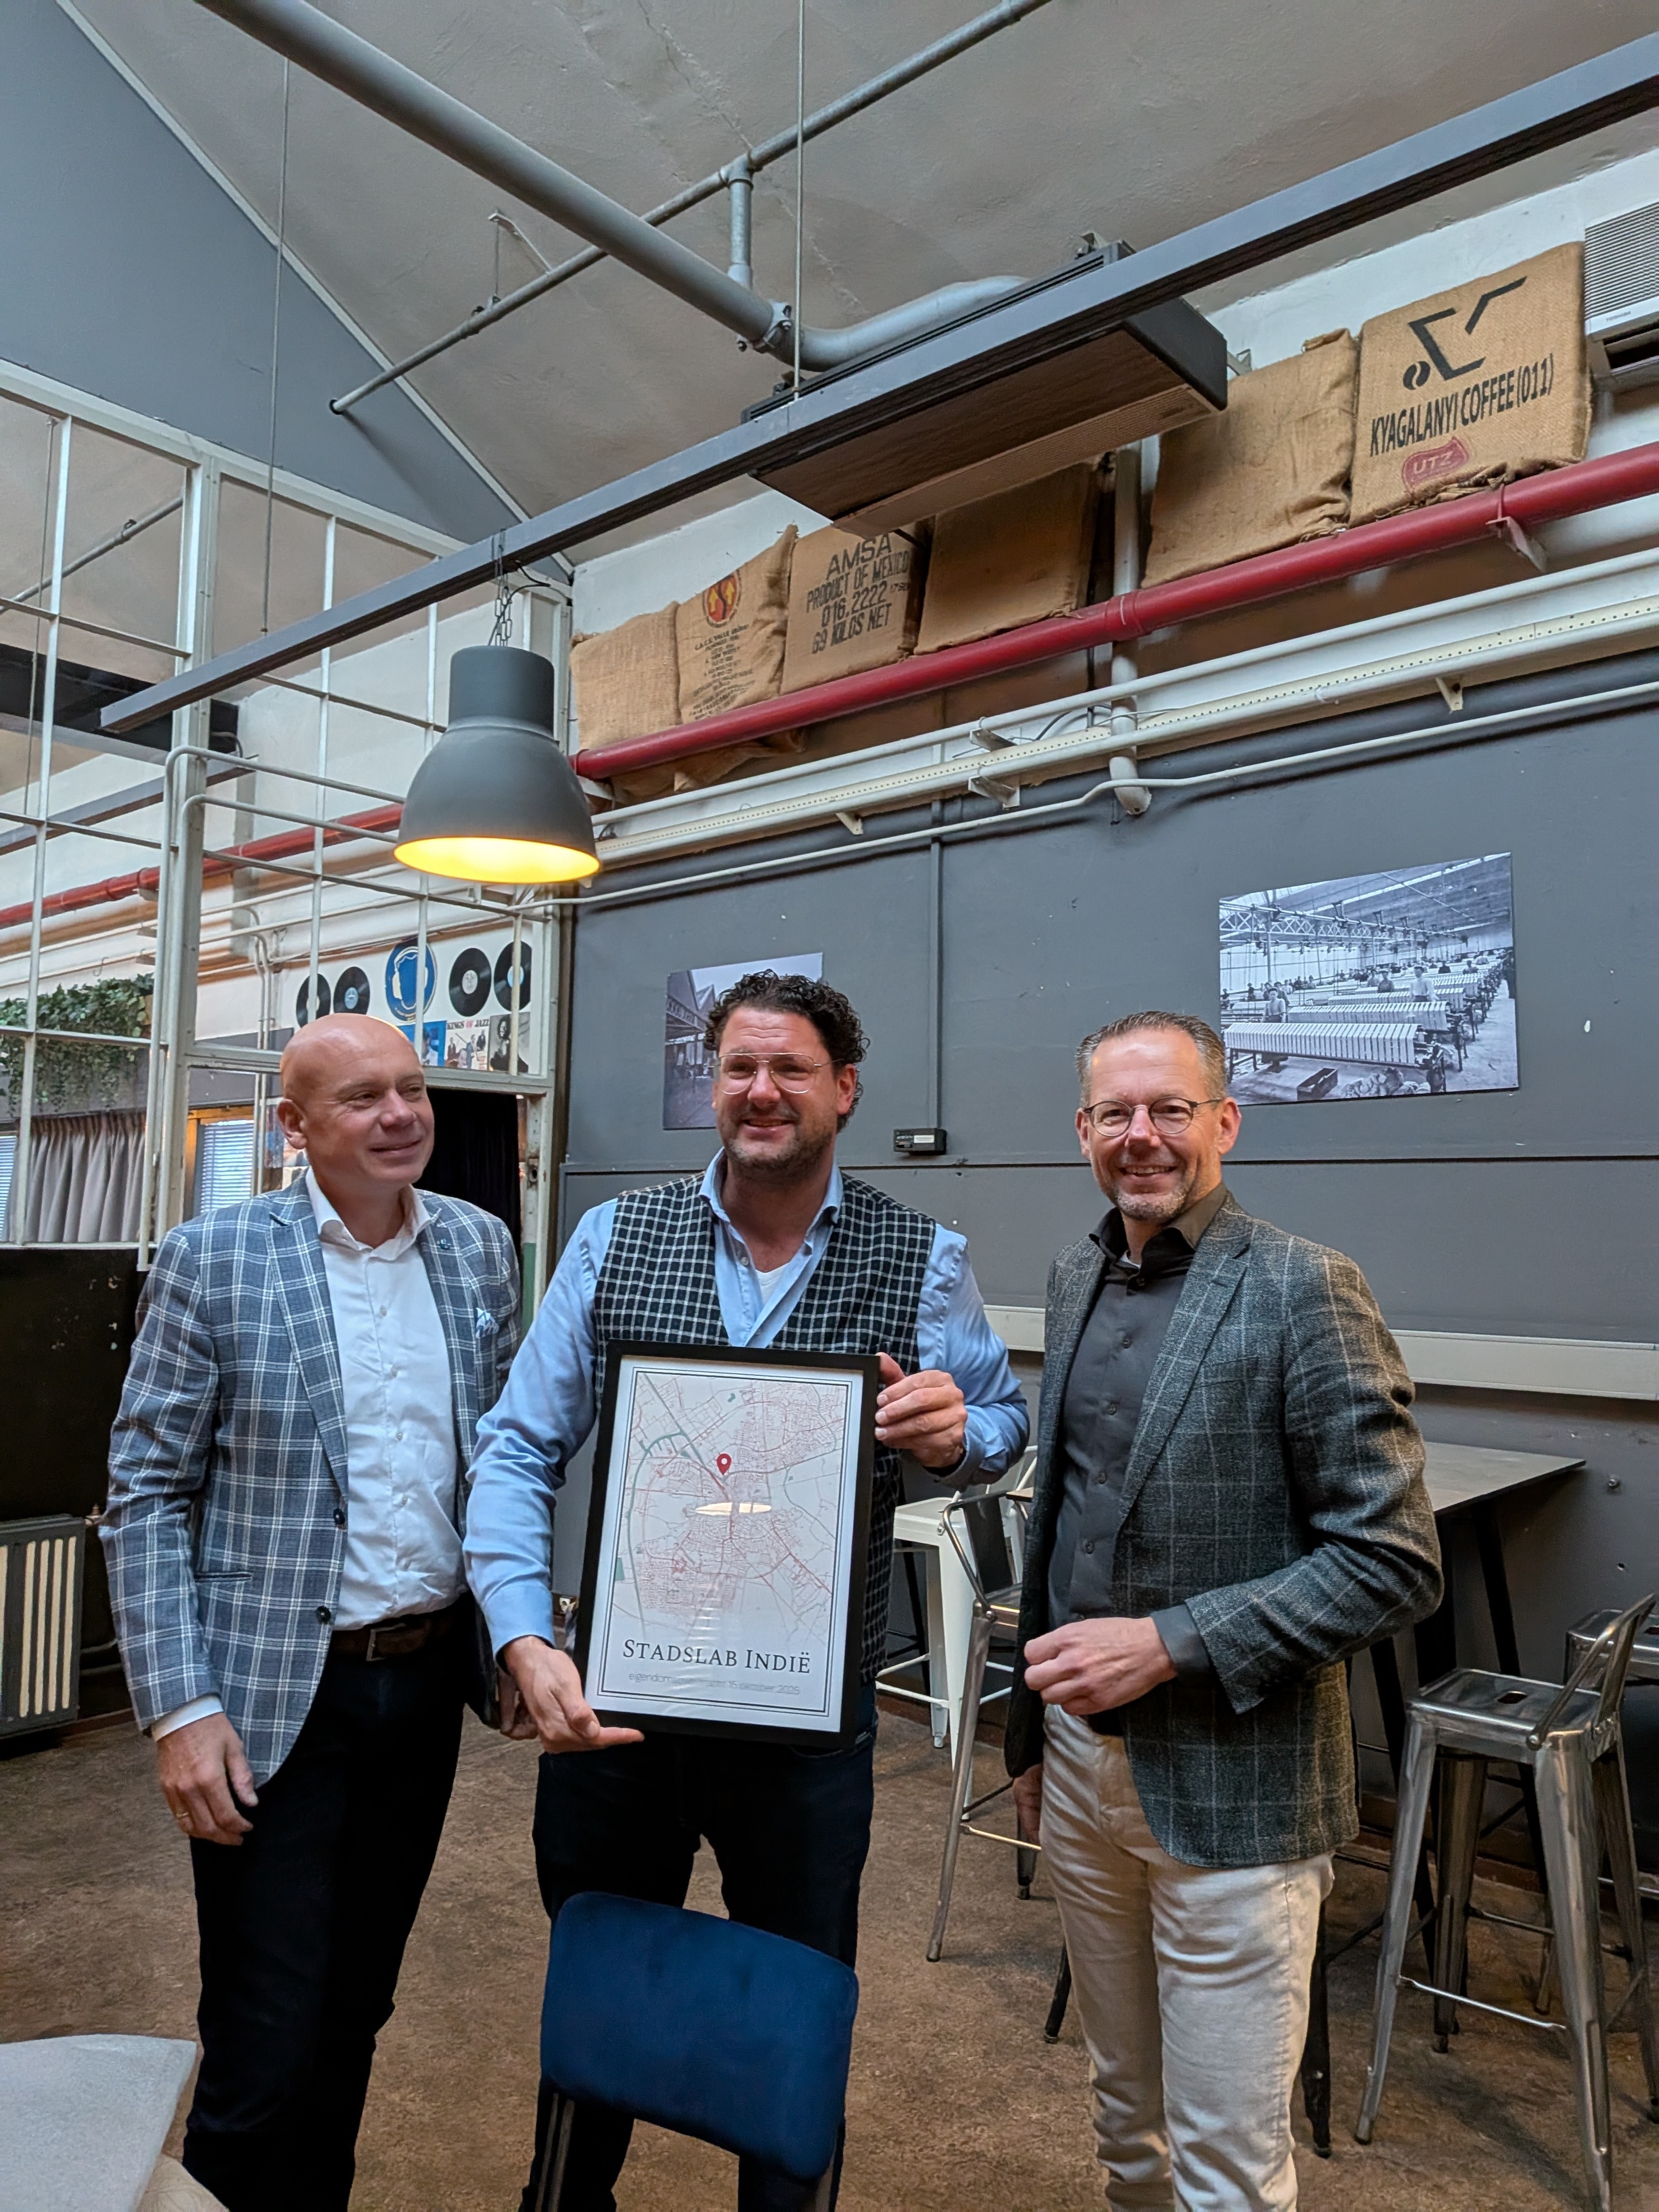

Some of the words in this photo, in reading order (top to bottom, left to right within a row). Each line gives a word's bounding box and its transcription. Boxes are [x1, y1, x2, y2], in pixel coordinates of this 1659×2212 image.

[1370, 392, 1458, 457] KYAGALANYI
[1460, 370, 1515, 426] COFFEE
[1517, 353, 1554, 408] (011)
[1413, 450, 1454, 475] UTZ
[826, 533, 892, 580] AMSA
[807, 572, 851, 613] PRODUCT
[853, 564, 869, 590] OF
[872, 550, 911, 583] MEXICO
[831, 612, 865, 646] KILOS
[867, 603, 892, 632] NET
[474, 1019, 489, 1027] JAZZ
[623, 1639, 737, 1667] STADSLAB
[745, 1649, 810, 1673] INDIË
